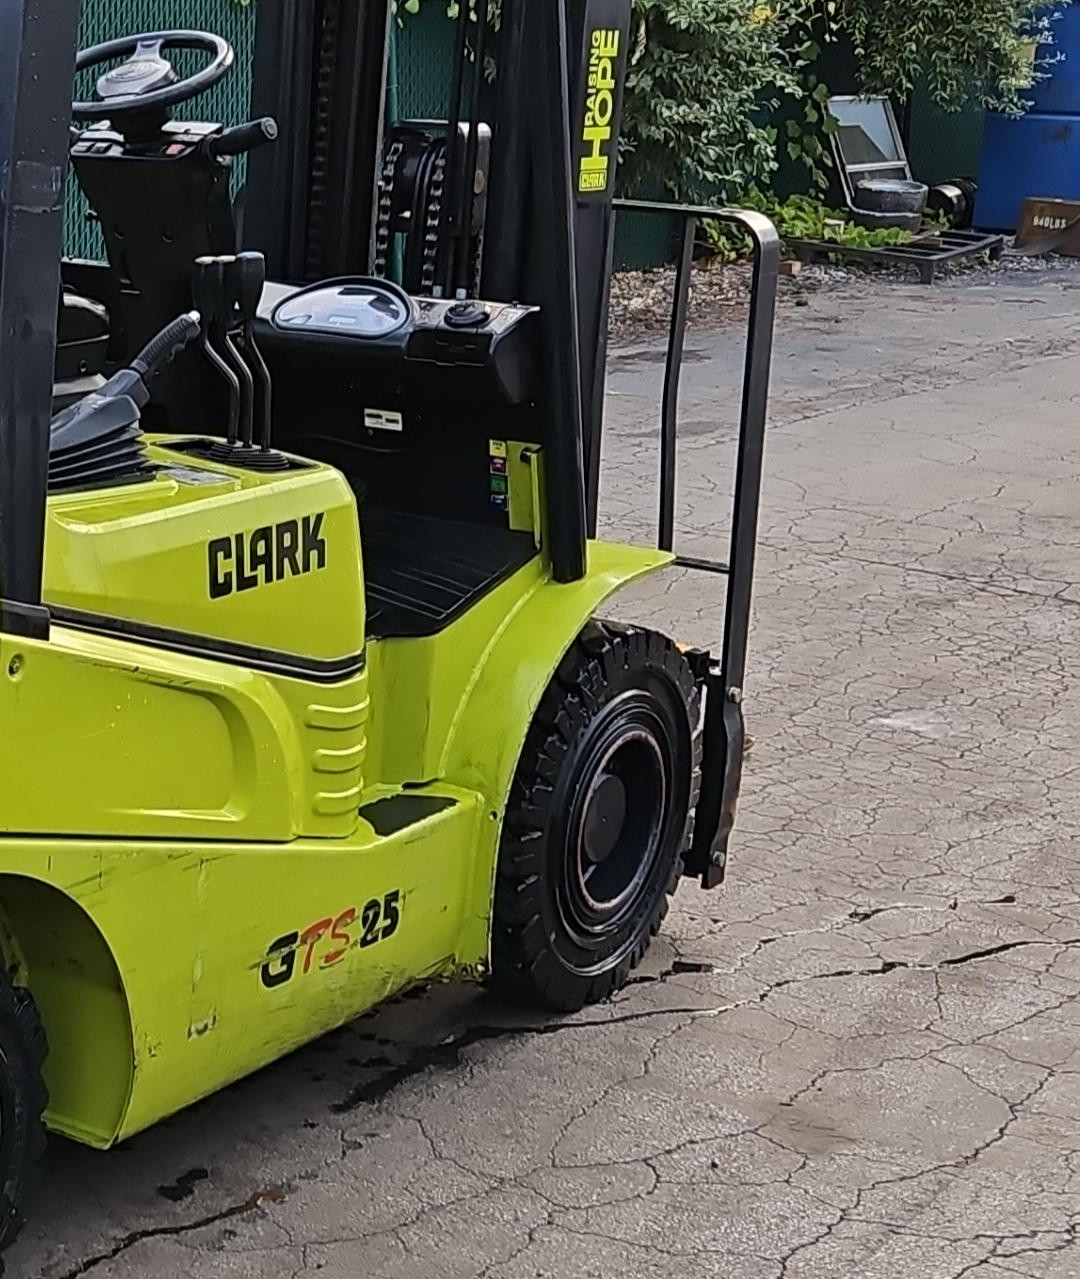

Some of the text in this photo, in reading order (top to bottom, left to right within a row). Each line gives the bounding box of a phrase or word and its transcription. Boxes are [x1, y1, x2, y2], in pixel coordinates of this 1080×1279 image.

[580, 30, 620, 170] HOPE
[584, 30, 601, 127] RAISING
[580, 172, 606, 188] CLARK
[207, 511, 326, 600] CLARK
